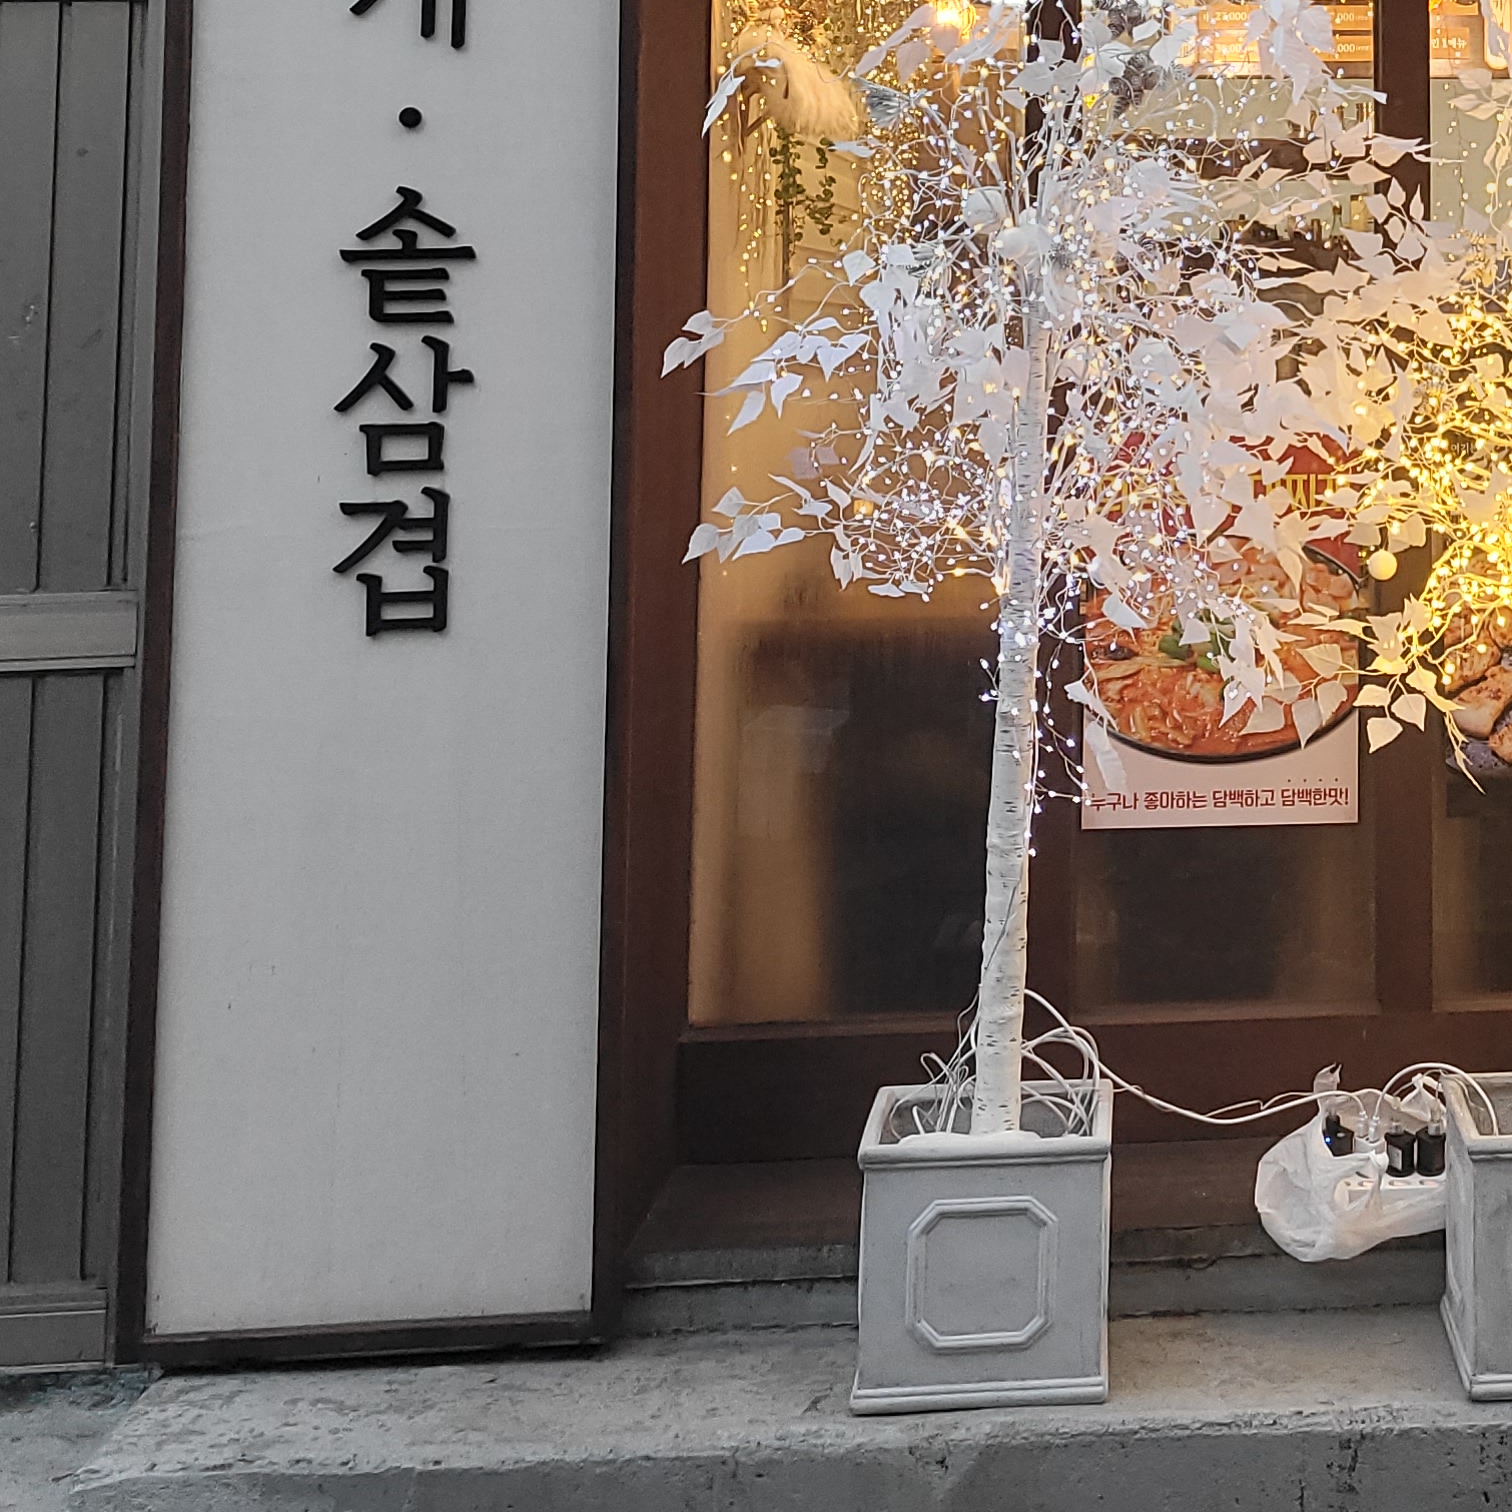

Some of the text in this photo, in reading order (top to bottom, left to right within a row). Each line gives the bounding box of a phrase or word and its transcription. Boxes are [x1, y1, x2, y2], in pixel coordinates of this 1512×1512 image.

[333, 185, 478, 638] 솥삼겹
[1090, 786, 1350, 812] 누구나 좋아하는 담백하고 담백한맛!
